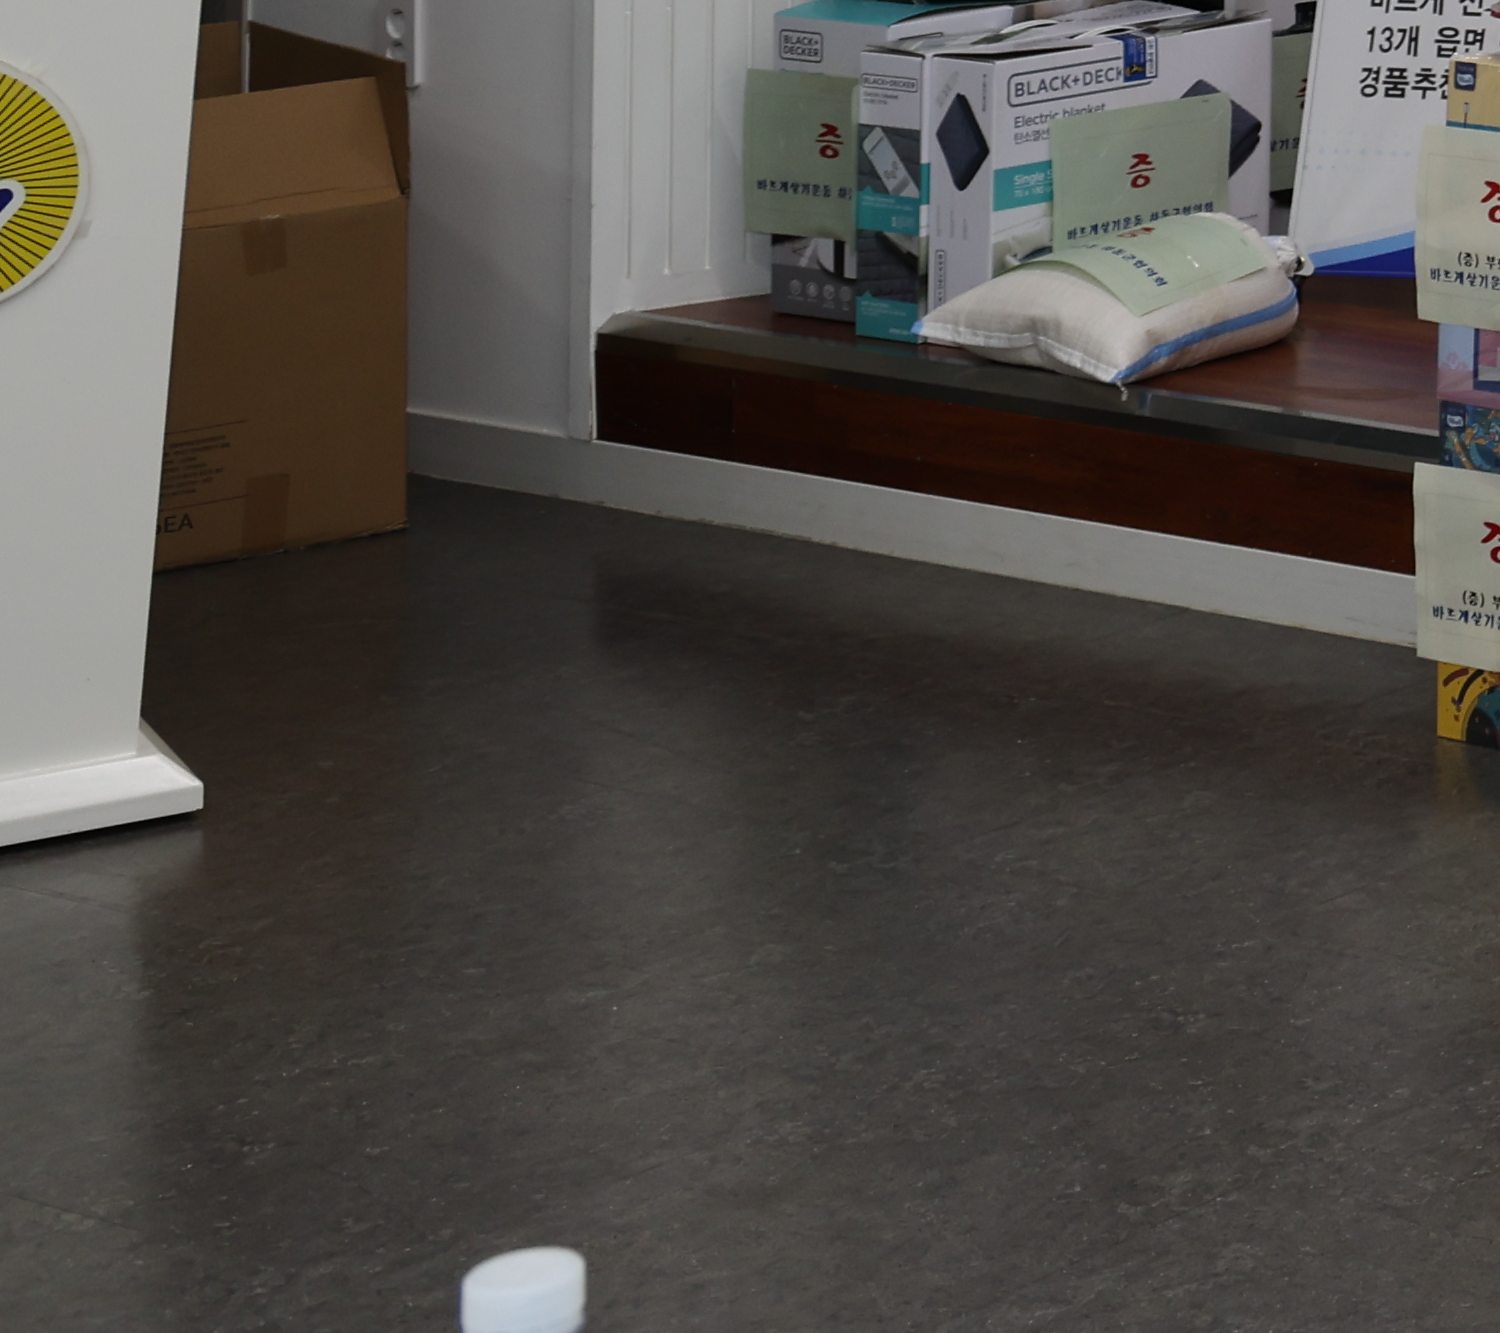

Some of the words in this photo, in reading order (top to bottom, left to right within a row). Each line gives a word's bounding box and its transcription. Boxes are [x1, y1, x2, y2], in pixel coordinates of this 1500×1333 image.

[1365, 26, 1419, 57] 13개
[1014, 110, 1059, 128] Electric
[816, 123, 843, 159] 증
[1126, 153, 1156, 188] 증
[1458, 252, 1479, 268] (증)
